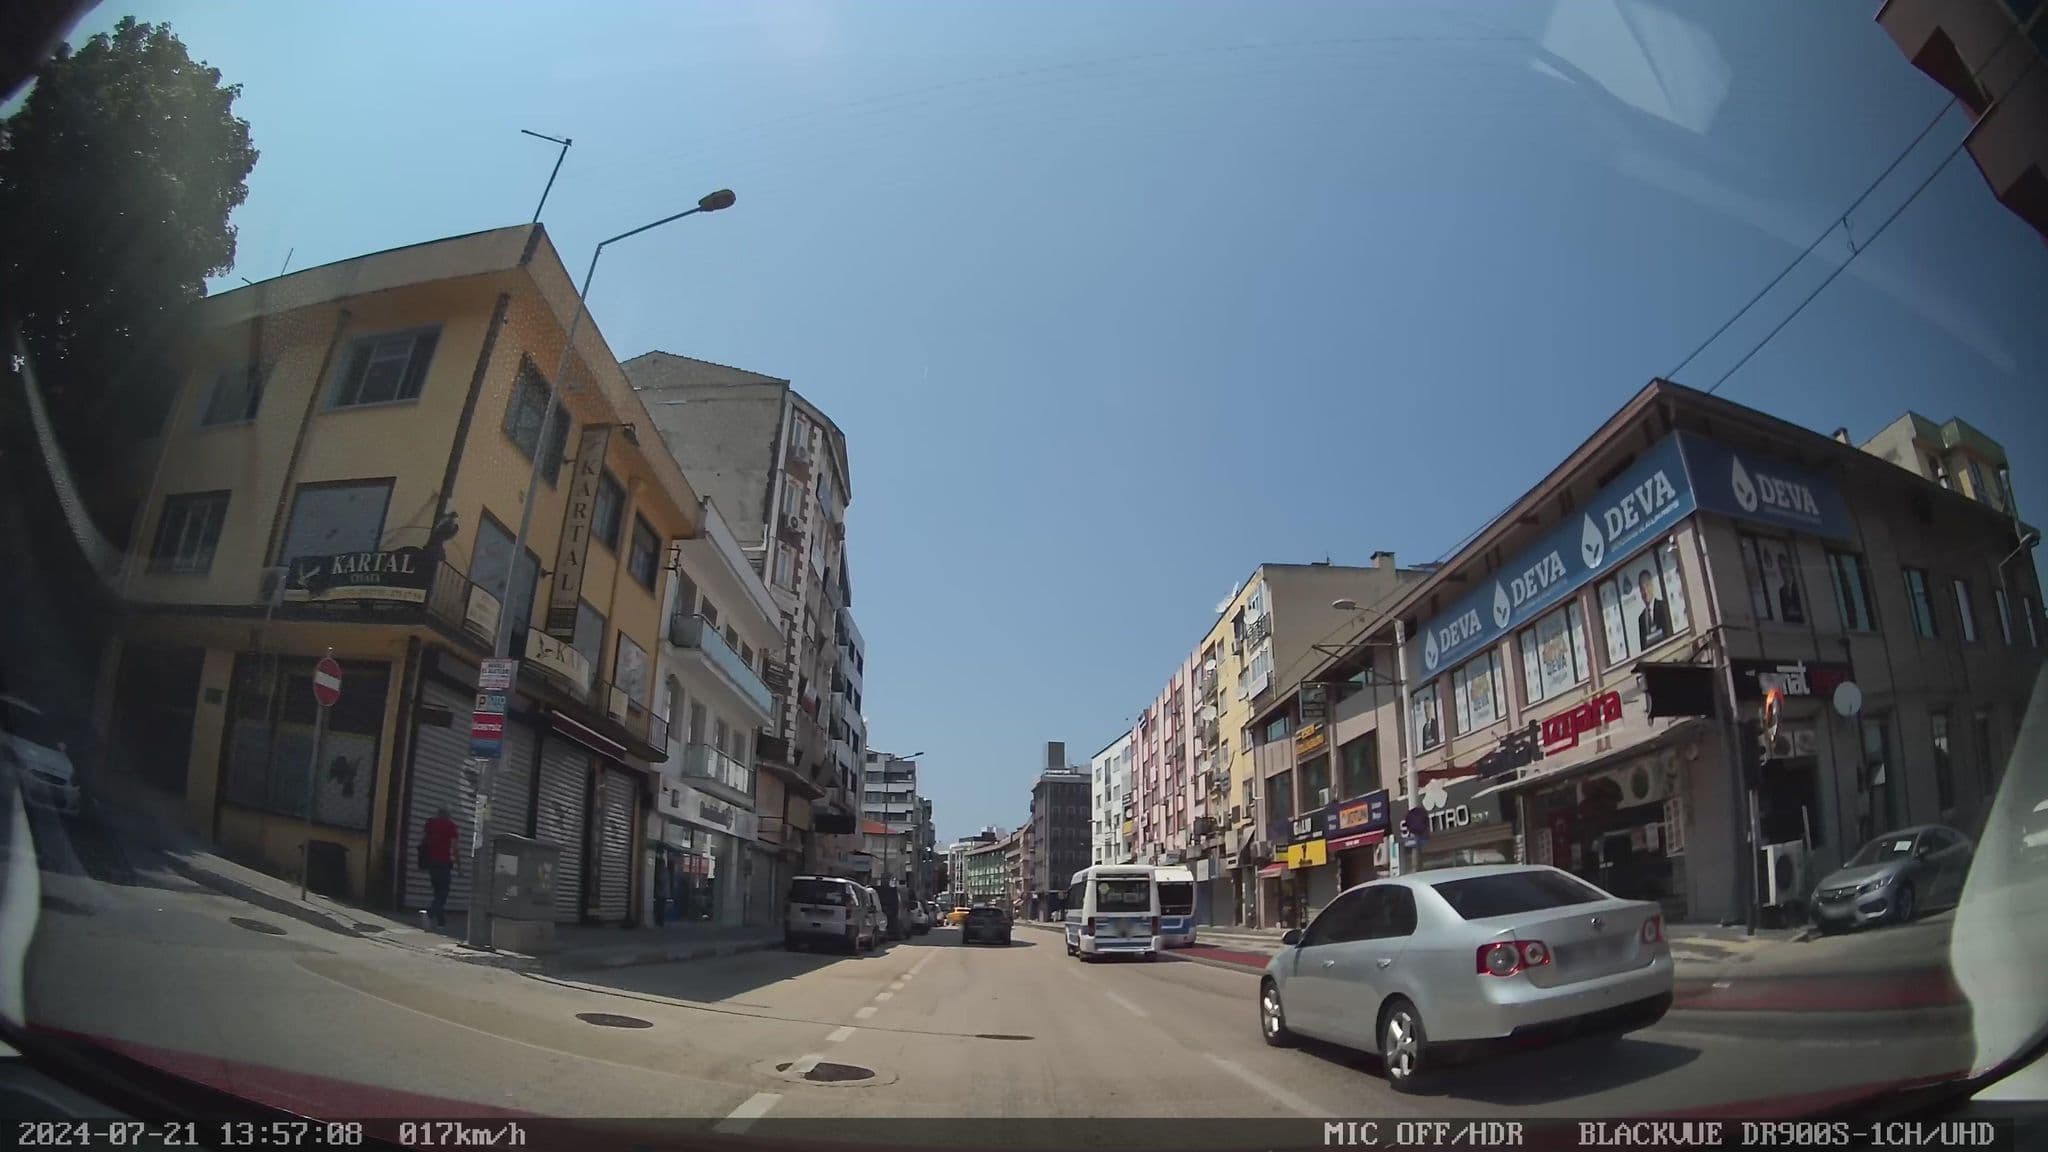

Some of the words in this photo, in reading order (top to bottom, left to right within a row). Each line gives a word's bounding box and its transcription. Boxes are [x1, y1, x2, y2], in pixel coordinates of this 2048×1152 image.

[1604, 469, 1676, 542] DEVA
[1756, 473, 1820, 515] DEVA
[561, 458, 596, 592] KARTAL
[332, 552, 417, 575] KARTAL
[1511, 550, 1566, 608] DEVA
[1439, 608, 1482, 653] DEVA
